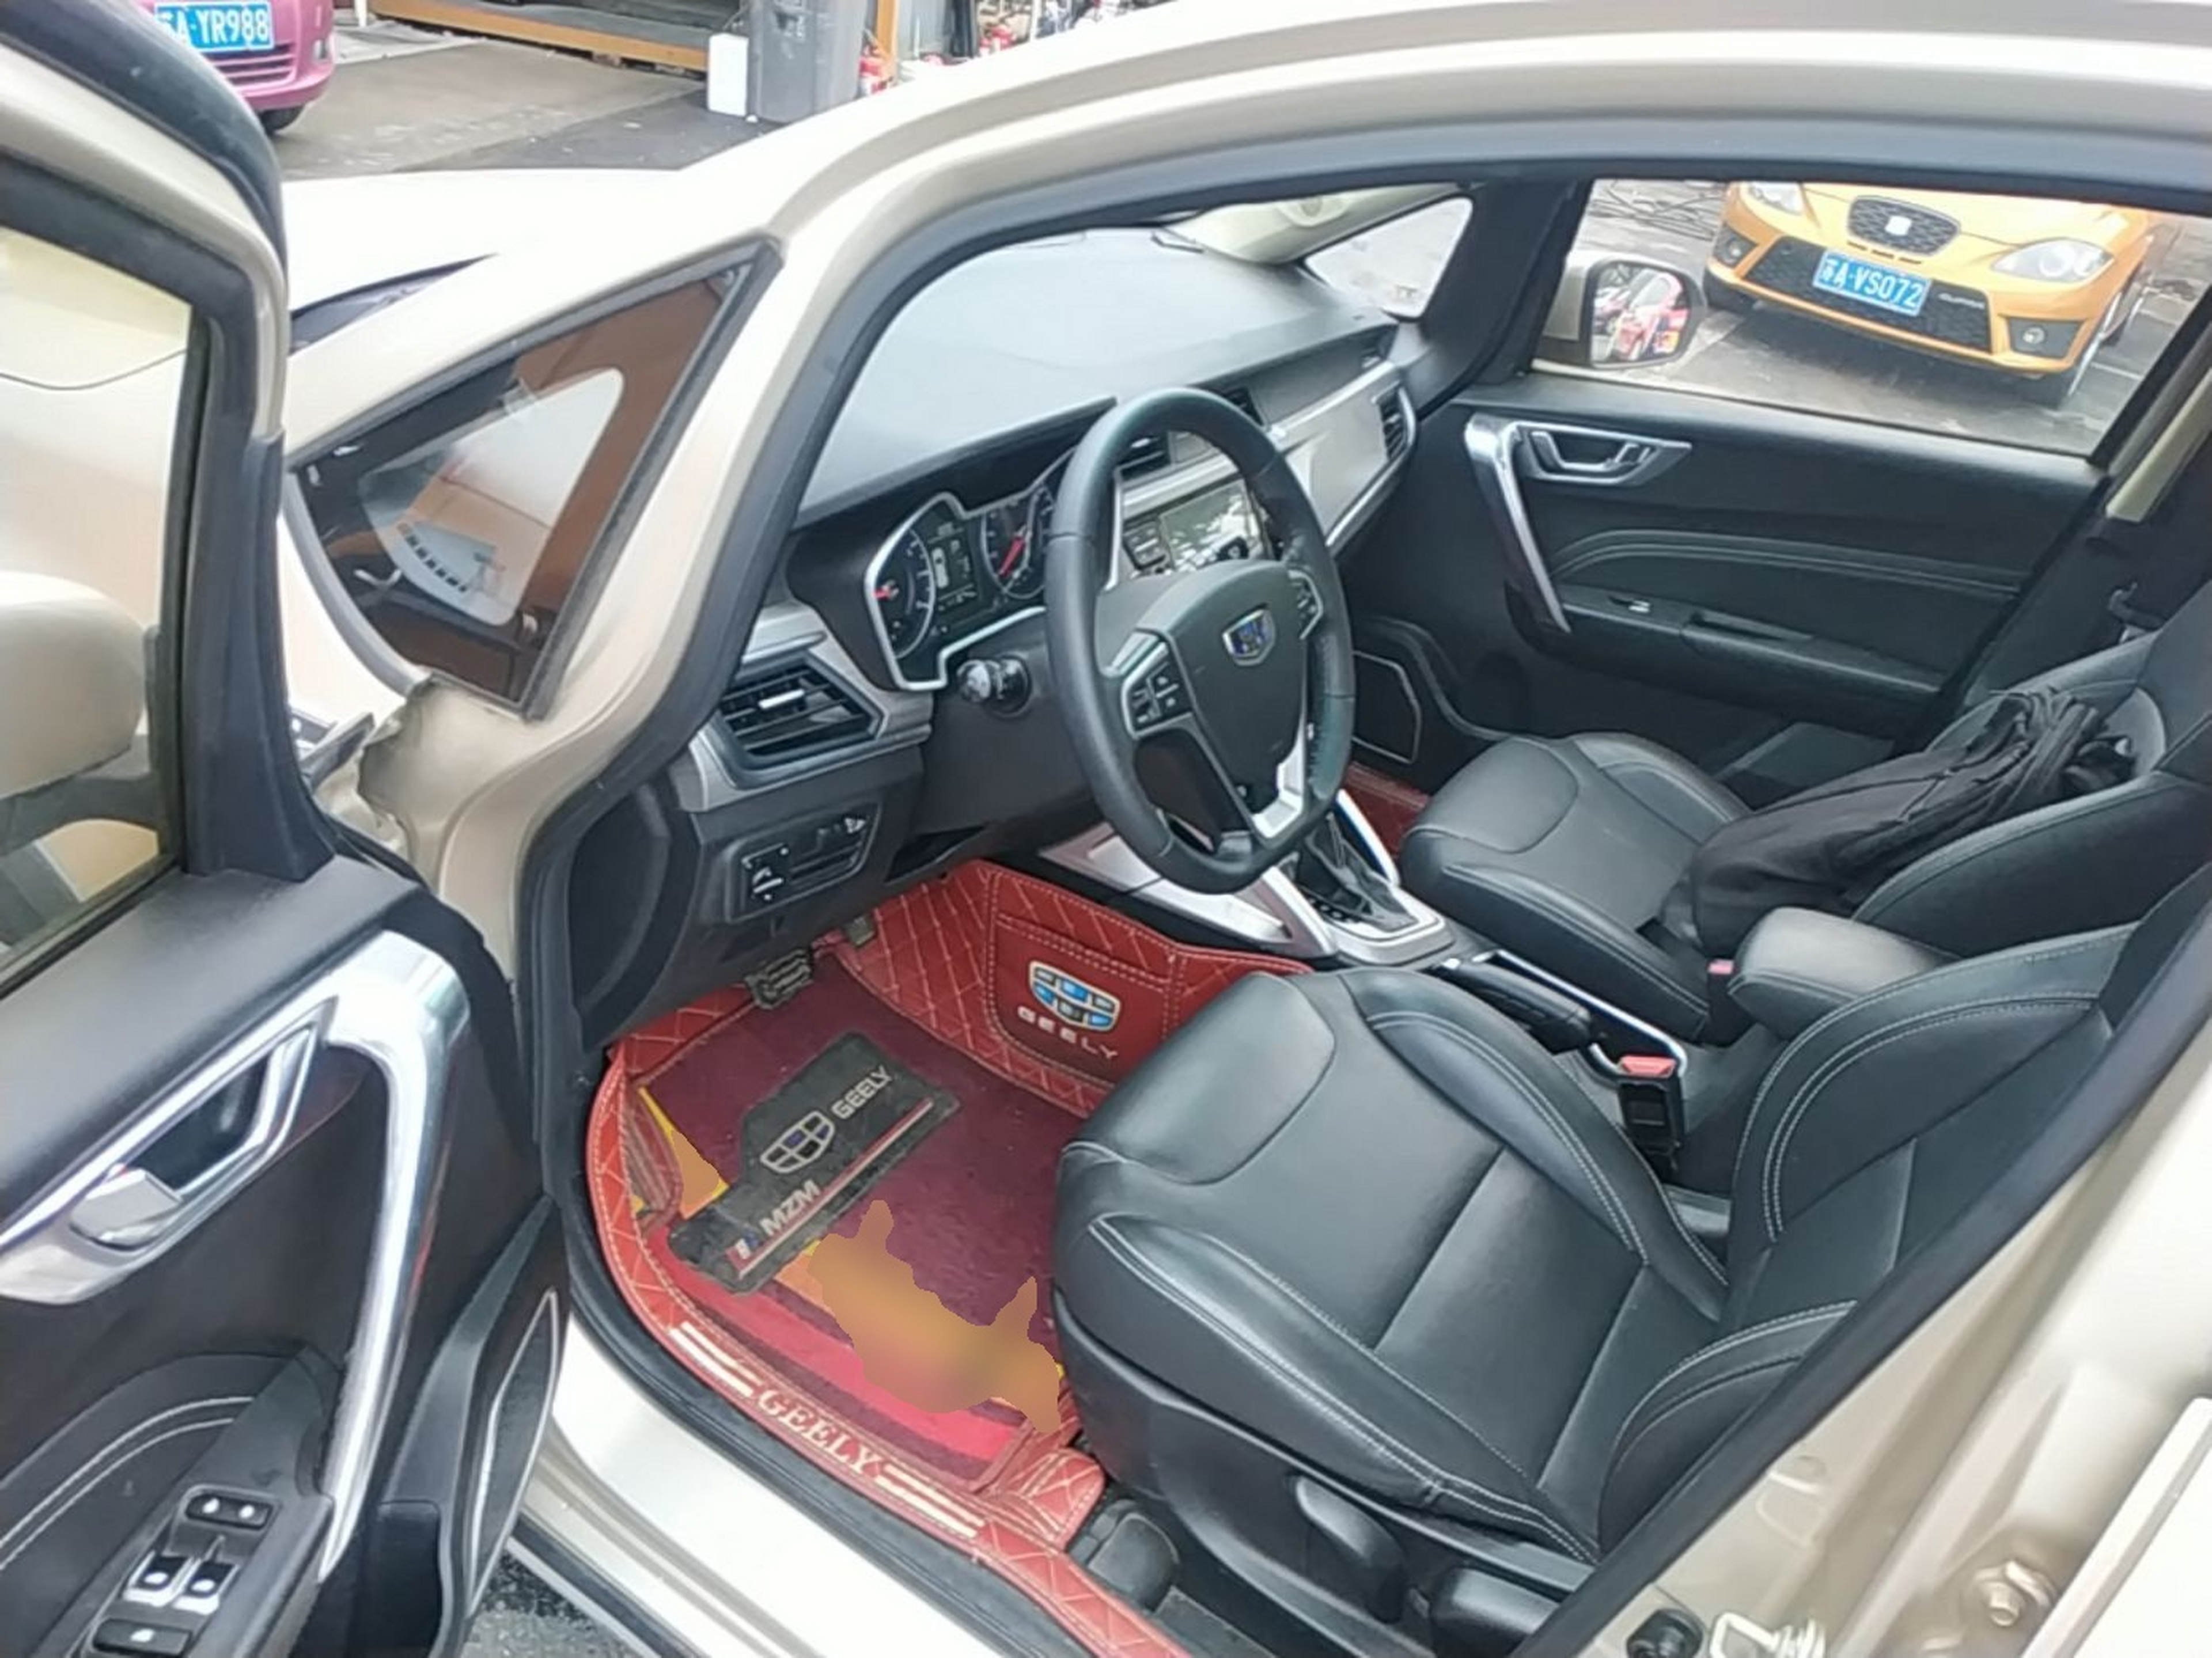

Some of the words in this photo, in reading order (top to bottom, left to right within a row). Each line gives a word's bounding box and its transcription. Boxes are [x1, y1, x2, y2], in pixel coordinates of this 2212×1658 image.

[1017, 1006, 1118, 1059] GEELY
[831, 1064, 893, 1120] GEELY
[759, 1179, 821, 1236] MZM
[757, 1388, 884, 1475] GEELY
